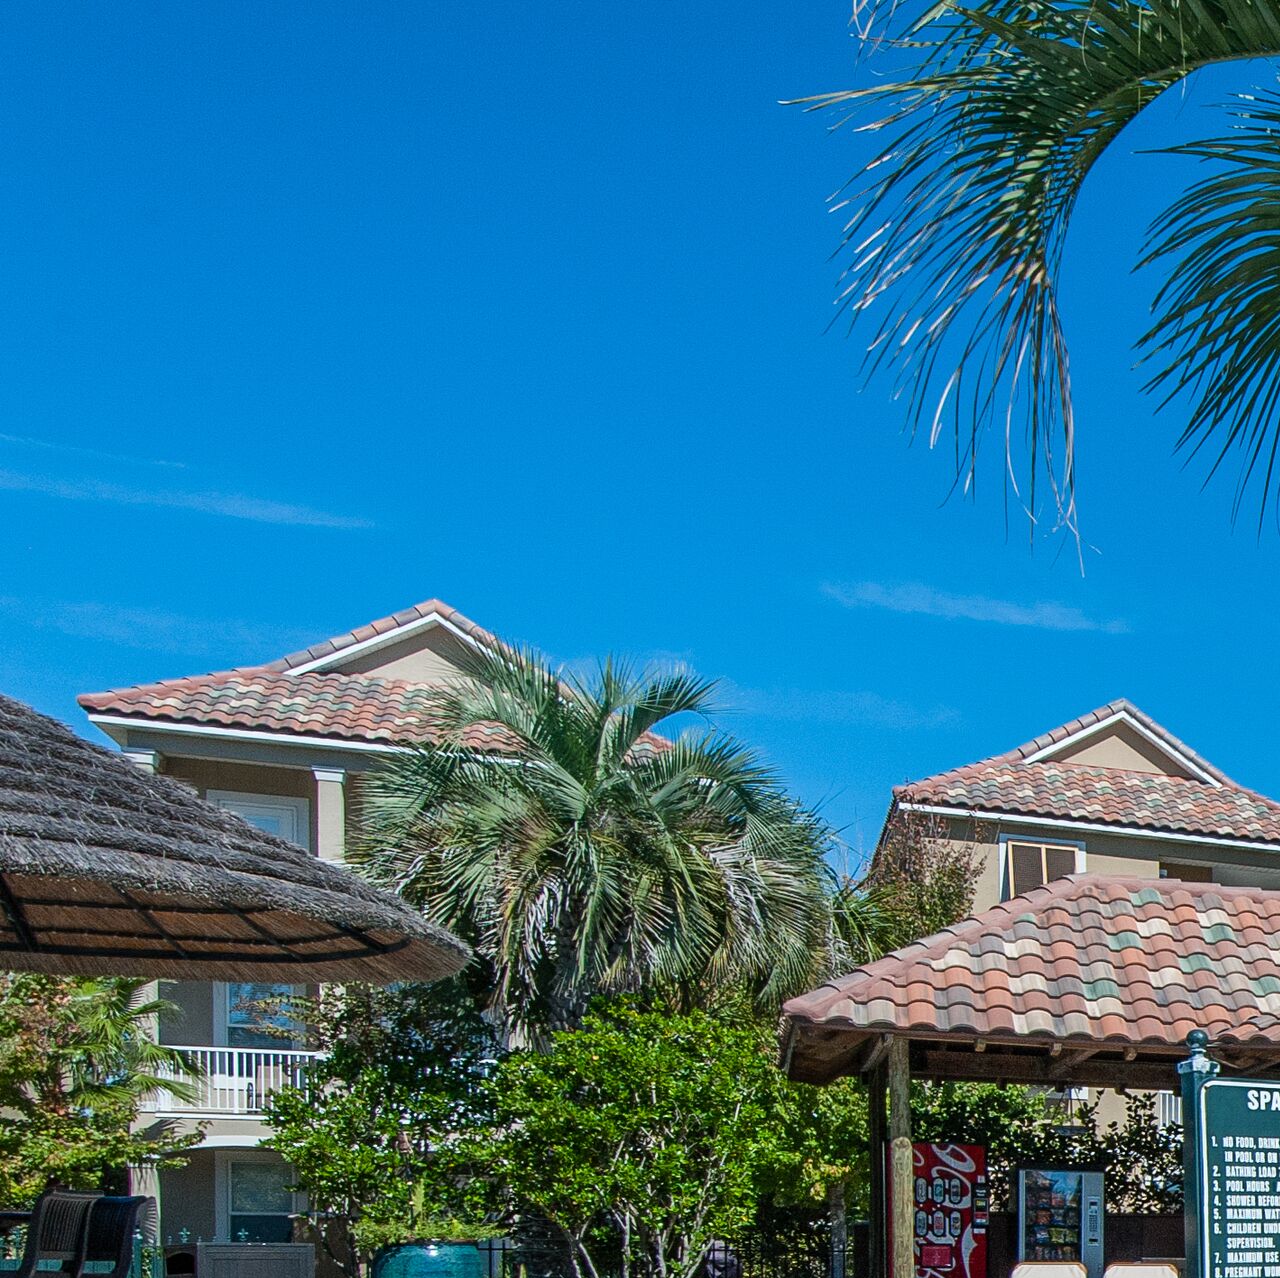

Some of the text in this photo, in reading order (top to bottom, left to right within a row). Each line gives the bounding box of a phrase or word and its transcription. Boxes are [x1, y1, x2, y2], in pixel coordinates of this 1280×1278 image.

[1211, 1136, 1218, 1147] 1.
[1223, 1136, 1233, 1147] NO
[1225, 1151, 1233, 1162] IN
[1235, 1151, 1253, 1163] POOL
[1255, 1152, 1265, 1163] OR
[1268, 1152, 1278, 1163] ON
[1213, 1166, 1221, 1176] 2.
[1226, 1166, 1256, 1177] BATHING
[1259, 1167, 1277, 1177] LOAD
[1213, 1180, 1221, 1191] 3.
[1226, 1181, 1244, 1192] POOL
[1246, 1181, 1270, 1192] HOURS
[1214, 1195, 1221, 1206] 4.
[1226, 1195, 1255, 1206] SHOWER
[1213, 1208, 1221, 1219] 5.
[1226, 1209, 1262, 1219] MAXIMUM
[1214, 1223, 1221, 1234] 6.
[1227, 1223, 1261, 1234] CHILDREN
[1227, 1237, 1275, 1249] SUPERVISION.
[1214, 1253, 1222, 1264] 7.
[1227, 1252, 1263, 1263] MAXIMUM
[1265, 1252, 1279, 1263] USE
[1215, 1267, 1222, 1278] 8.
[1225, 1266, 1262, 1278] PREGNANT
